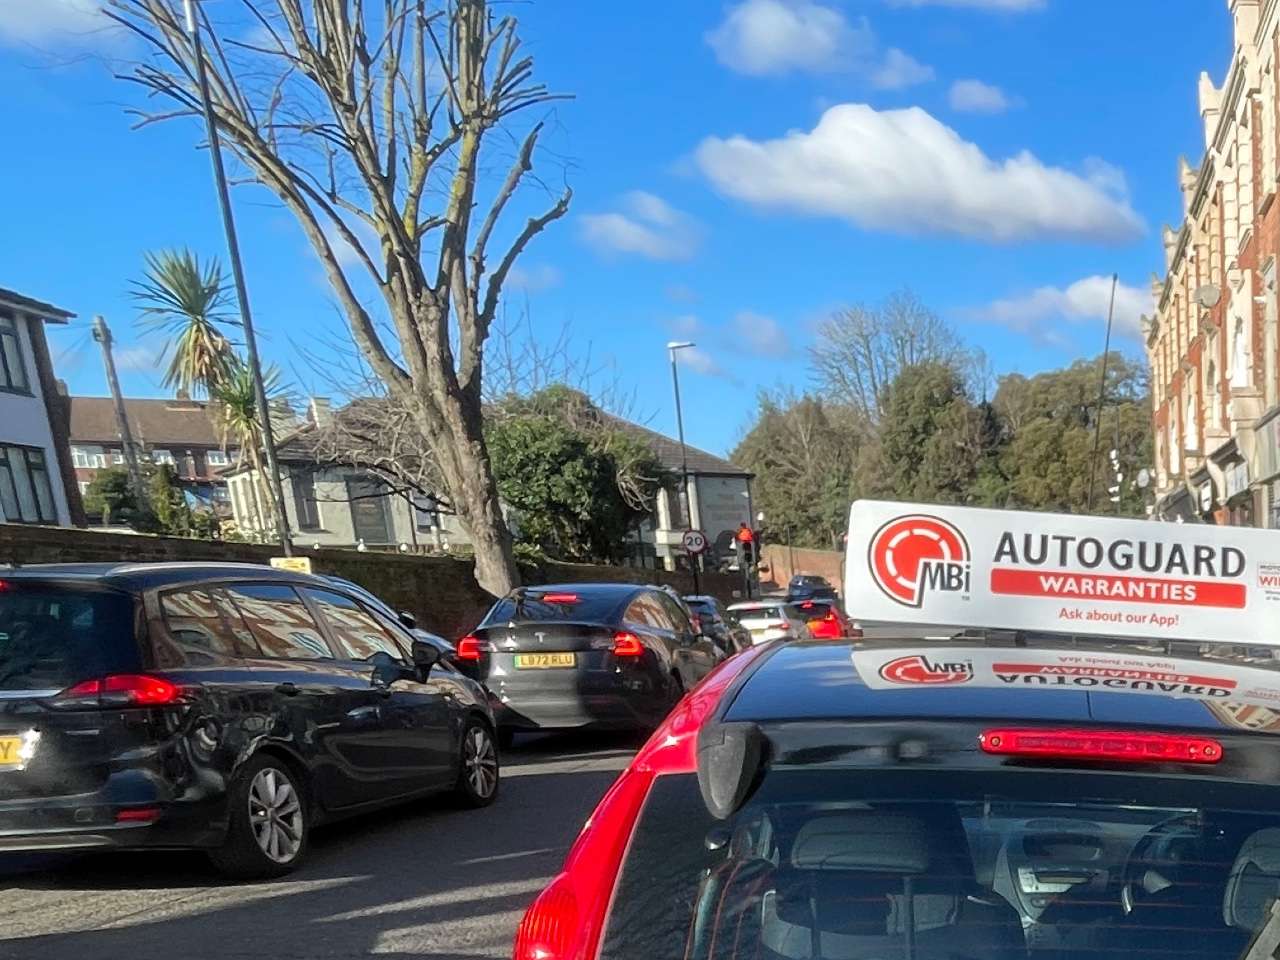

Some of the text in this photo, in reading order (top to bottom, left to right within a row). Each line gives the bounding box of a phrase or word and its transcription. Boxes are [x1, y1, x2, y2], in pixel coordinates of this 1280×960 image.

[687, 536, 701, 546] 20
[993, 531, 1246, 578] AUTOGUARD
[1039, 575, 1197, 601] WARRANTIES
[1059, 607, 1179, 626] Ask about our App!
